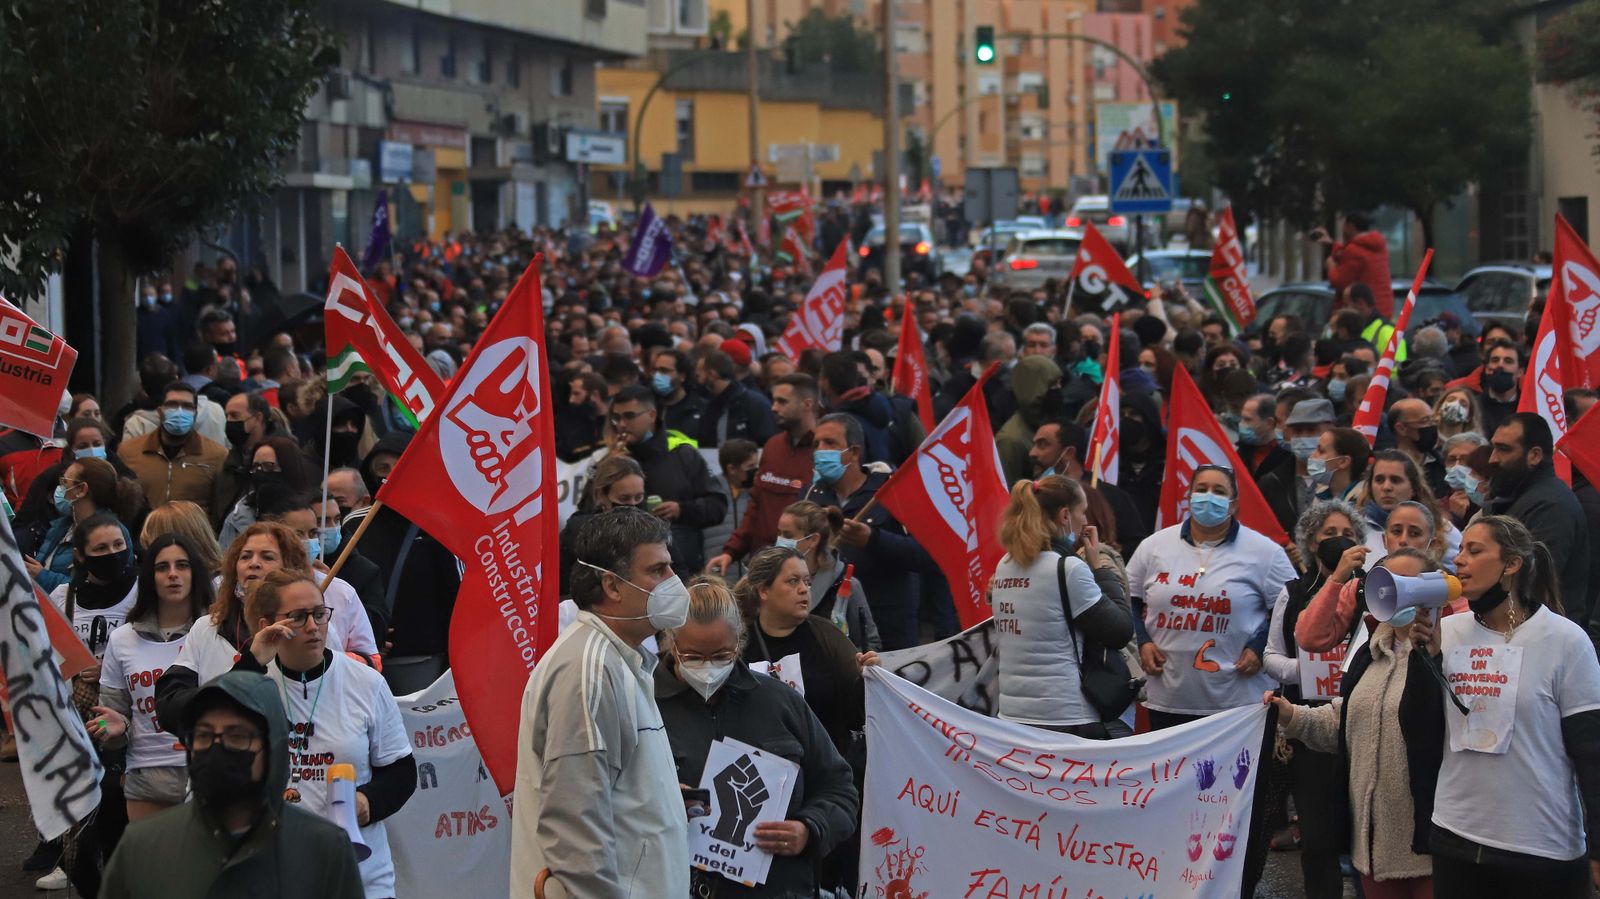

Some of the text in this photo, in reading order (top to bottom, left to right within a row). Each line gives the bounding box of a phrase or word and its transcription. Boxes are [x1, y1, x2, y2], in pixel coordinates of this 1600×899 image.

[999, 602, 1015, 614] DEL
[1469, 648, 1494, 659] POR
[1471, 660, 1488, 671] UN
[708, 843, 736, 860] del
[974, 811, 1048, 851] ESTÁ
[1057, 823, 1159, 882] VUESTRA
[693, 853, 744, 878] metal
